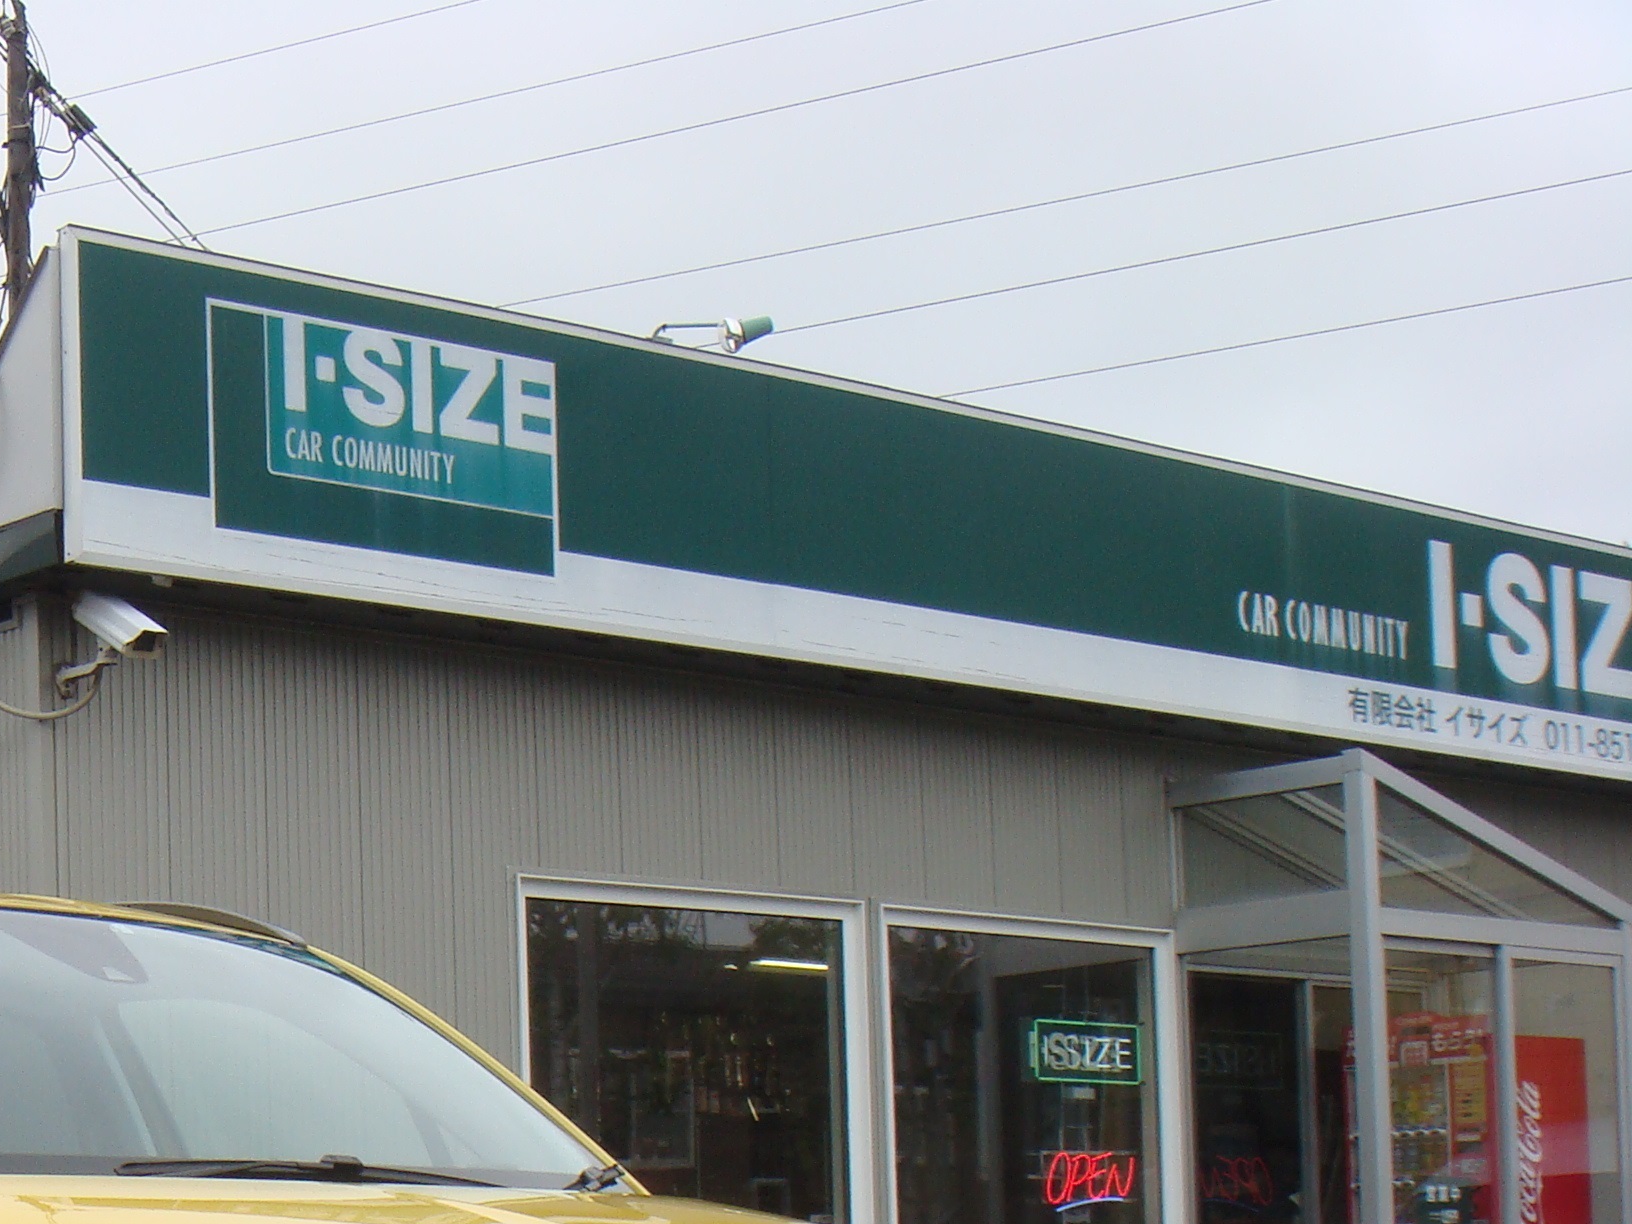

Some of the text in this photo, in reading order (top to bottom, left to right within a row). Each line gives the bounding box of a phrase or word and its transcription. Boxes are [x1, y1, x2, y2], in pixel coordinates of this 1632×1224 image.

[285, 427, 455, 484] CAR COMMUNITY
[1238, 590, 1409, 660] CAR COMMUNITY
[1348, 688, 1437, 733] 有限会社
[1446, 706, 1528, 745] イサイズ
[1045, 1151, 1135, 1205] OPEN
